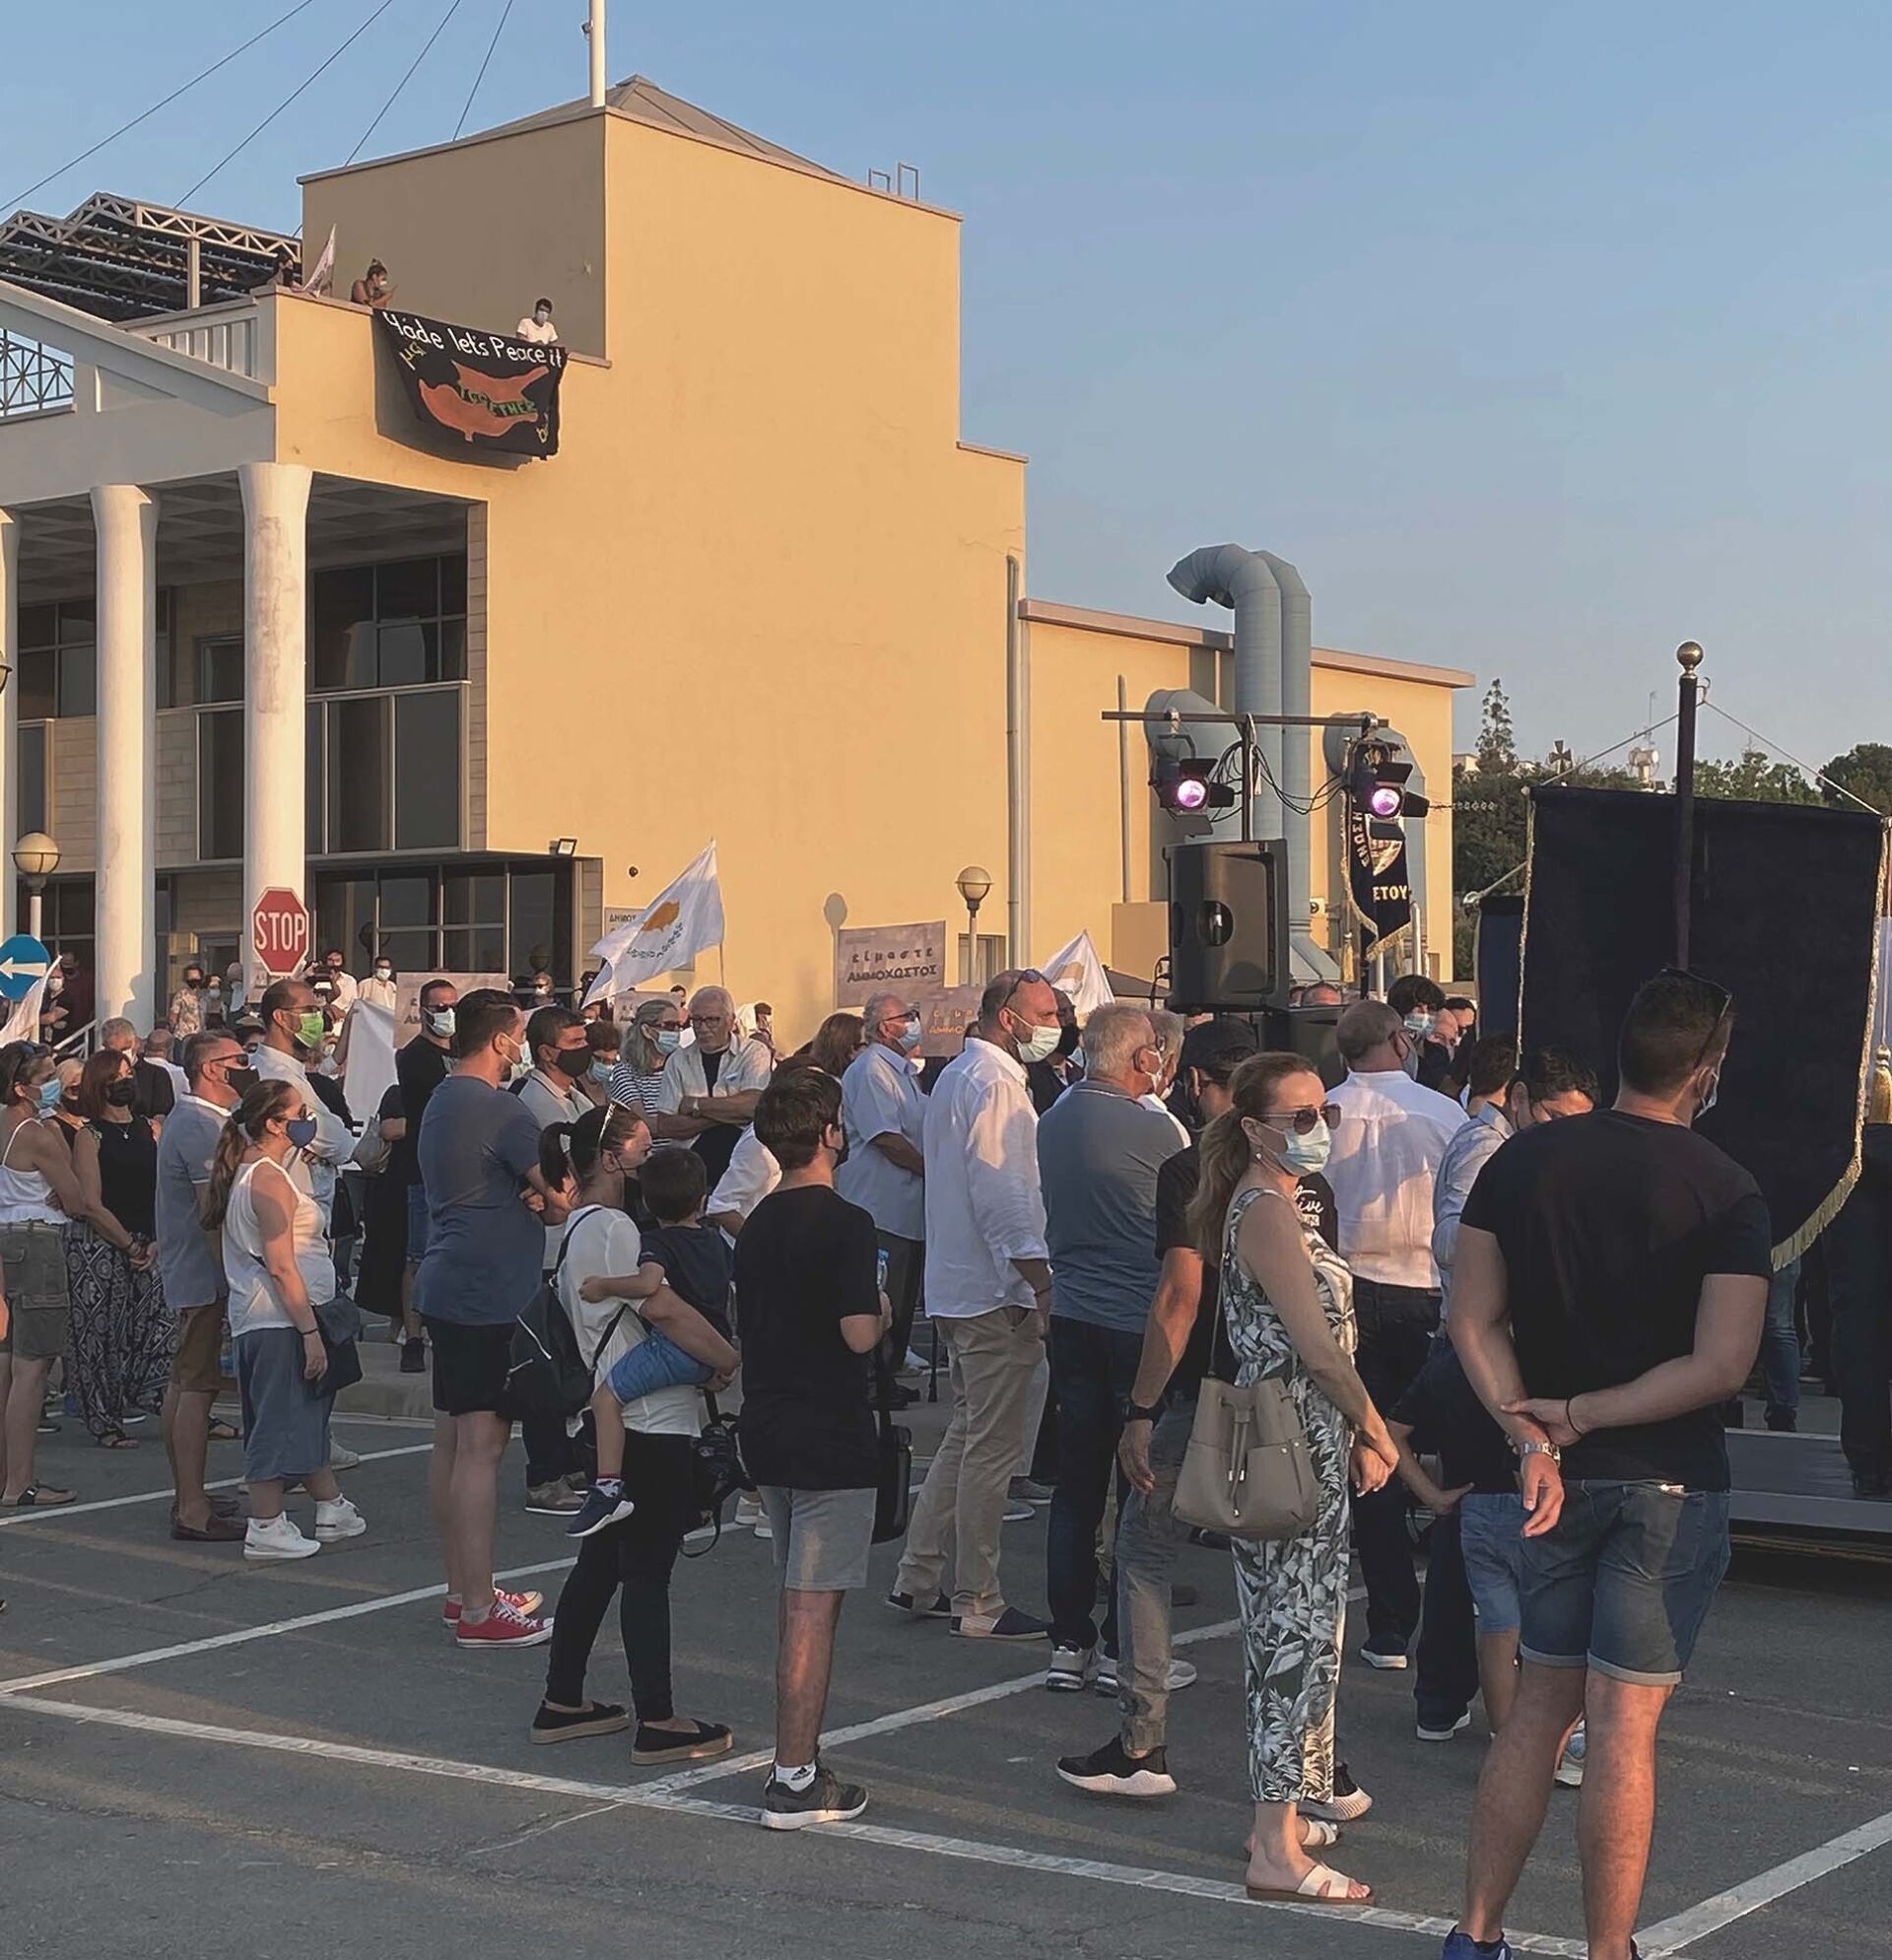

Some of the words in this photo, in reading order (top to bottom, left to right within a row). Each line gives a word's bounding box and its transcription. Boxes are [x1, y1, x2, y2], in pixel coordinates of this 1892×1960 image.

[489, 336, 547, 364] Peace
[548, 348, 563, 369] it
[255, 911, 305, 951] STOP
